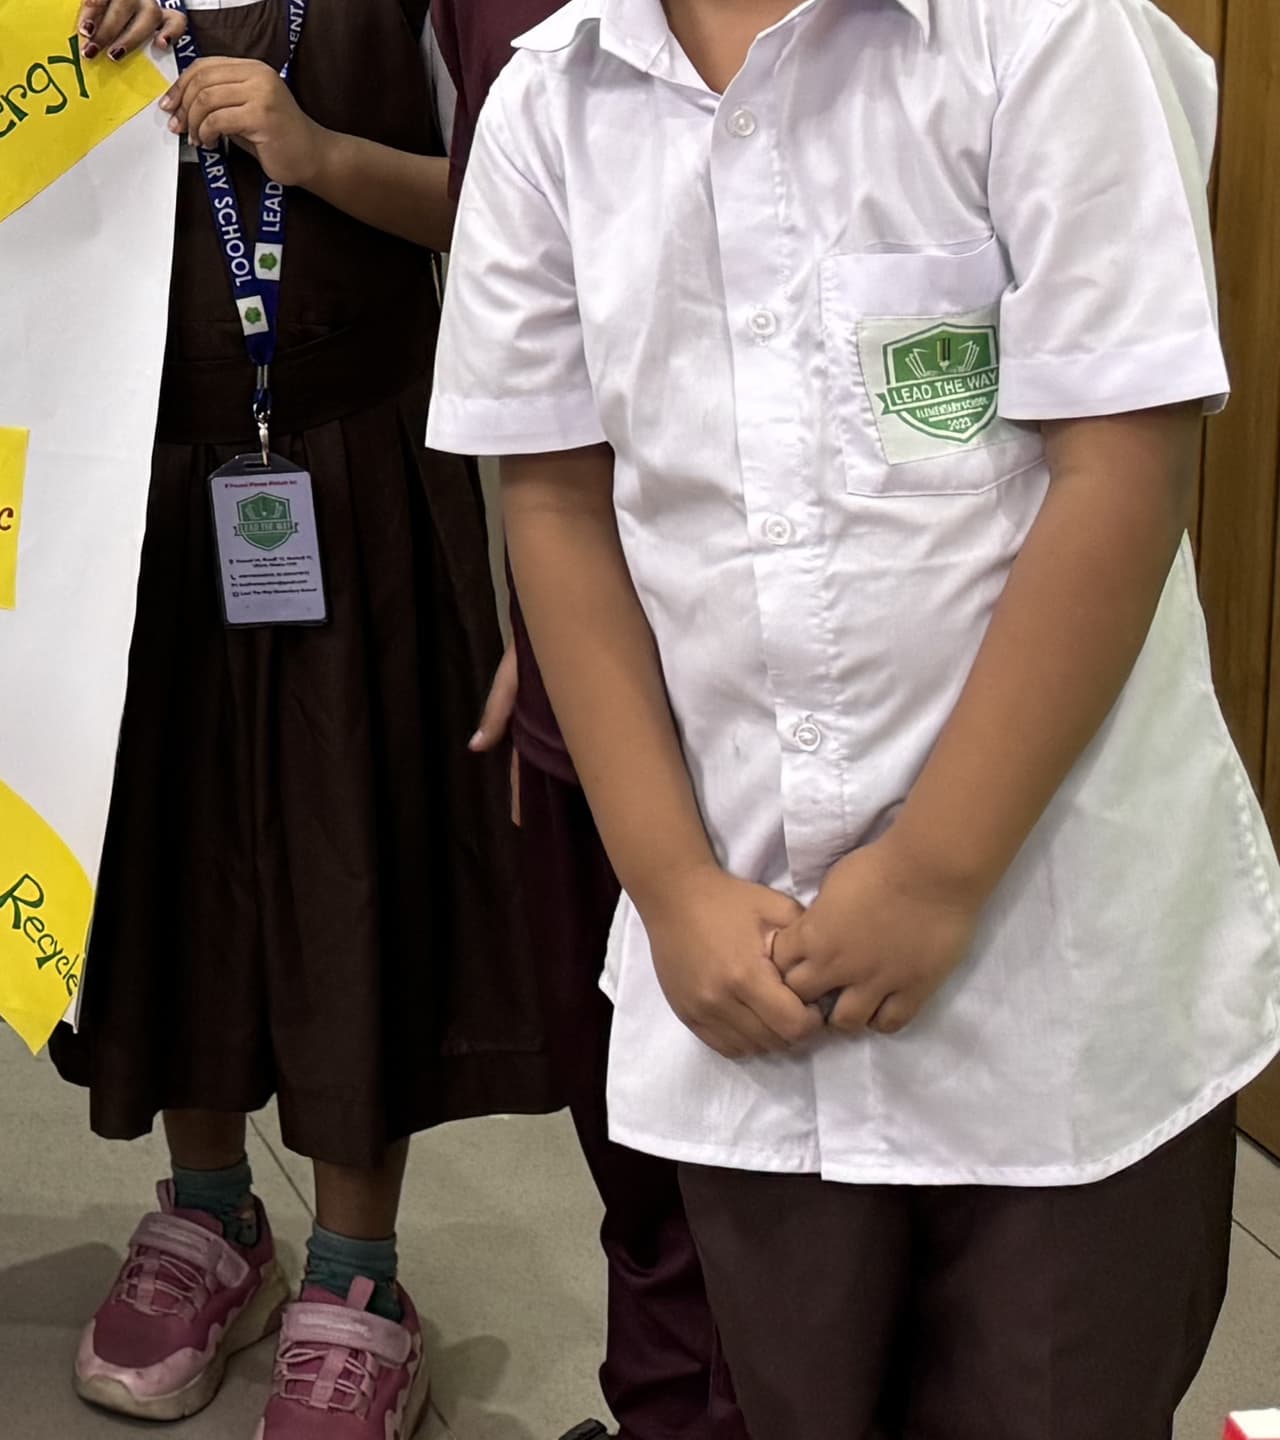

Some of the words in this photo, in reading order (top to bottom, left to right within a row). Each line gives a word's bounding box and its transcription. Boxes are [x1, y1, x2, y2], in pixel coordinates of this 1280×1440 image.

[262, 181, 283, 232] LEAD
[214, 196, 252, 287] SCHOOL
[892, 384, 932, 404] LEAD
[934, 378, 965, 397] THE
[967, 370, 997, 389] WAY
